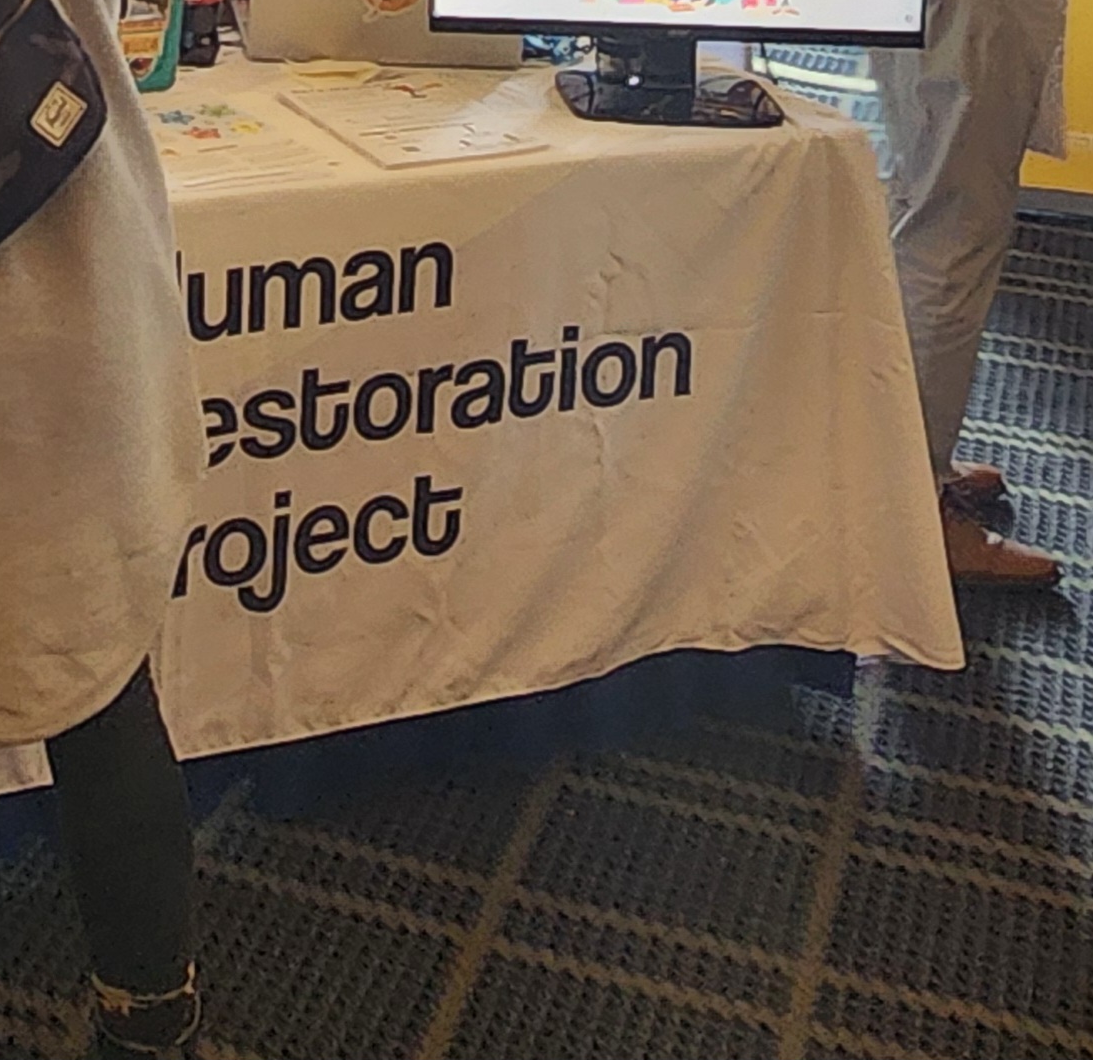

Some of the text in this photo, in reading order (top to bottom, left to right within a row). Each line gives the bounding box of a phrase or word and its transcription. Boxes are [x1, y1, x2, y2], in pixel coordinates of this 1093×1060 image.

[177, 241, 453, 342] uman
[201, 326, 691, 467] estoration
[171, 476, 462, 613] roject
